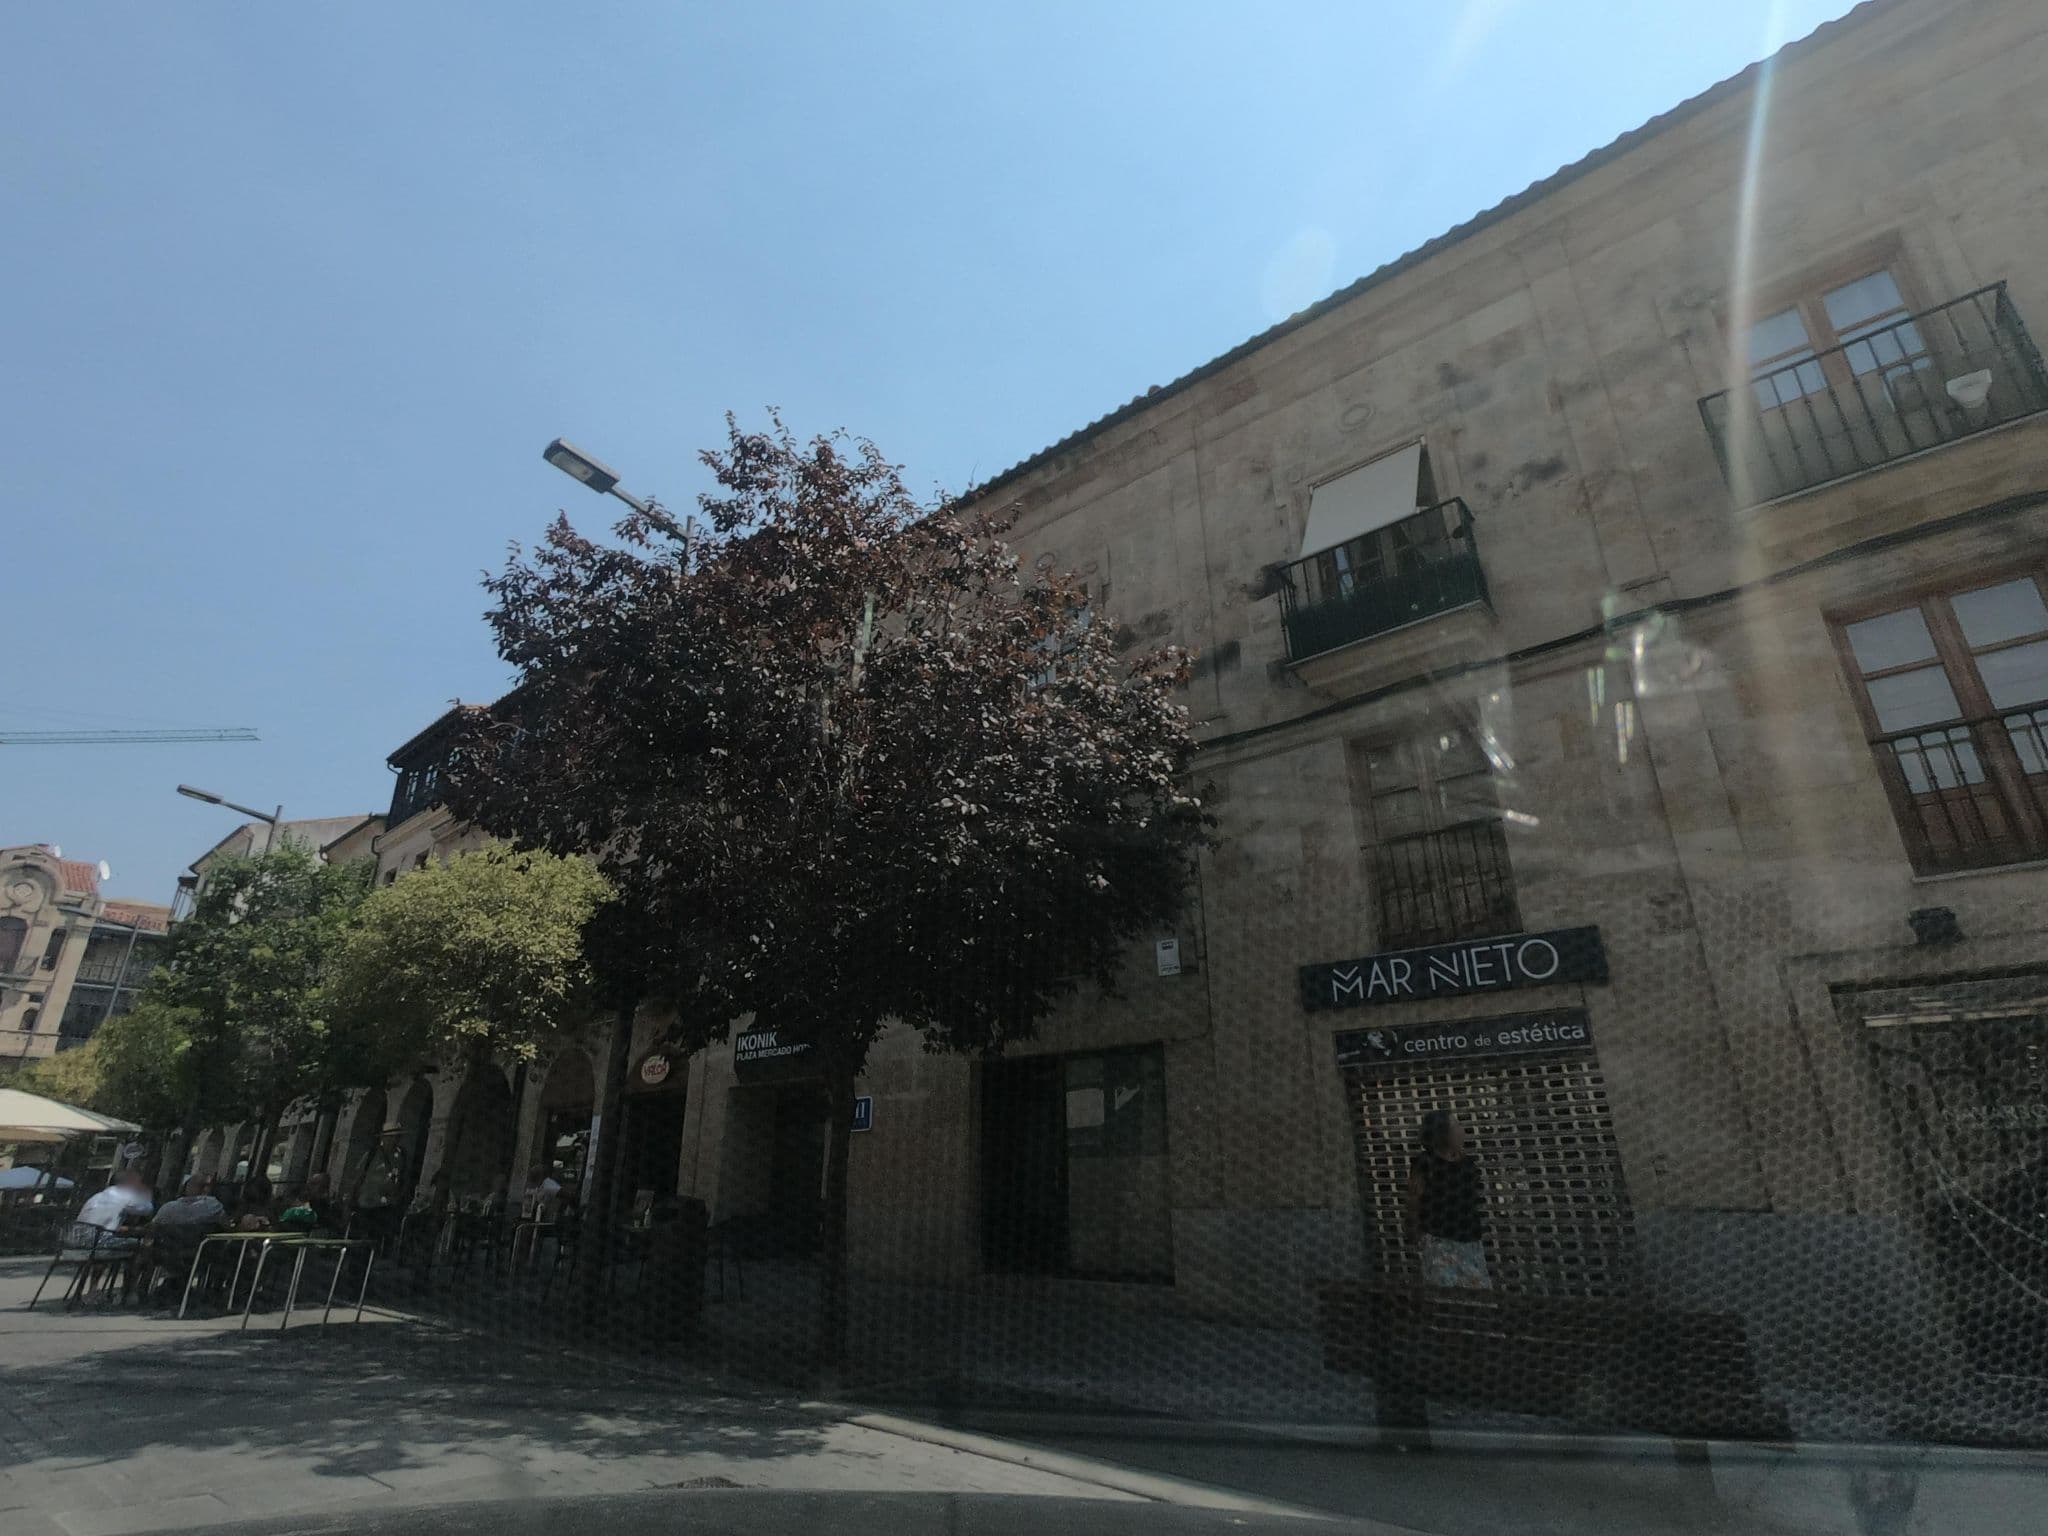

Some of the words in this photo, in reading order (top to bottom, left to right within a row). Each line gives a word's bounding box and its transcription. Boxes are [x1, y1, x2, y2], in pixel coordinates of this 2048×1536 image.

[1331, 957, 1413, 1002] MAR
[1429, 938, 1559, 991] NIETO
[737, 1031, 777, 1052] IKONIK
[1404, 1034, 1467, 1053] centro
[1474, 1034, 1491, 1047] de
[1497, 1021, 1585, 1045] estética
